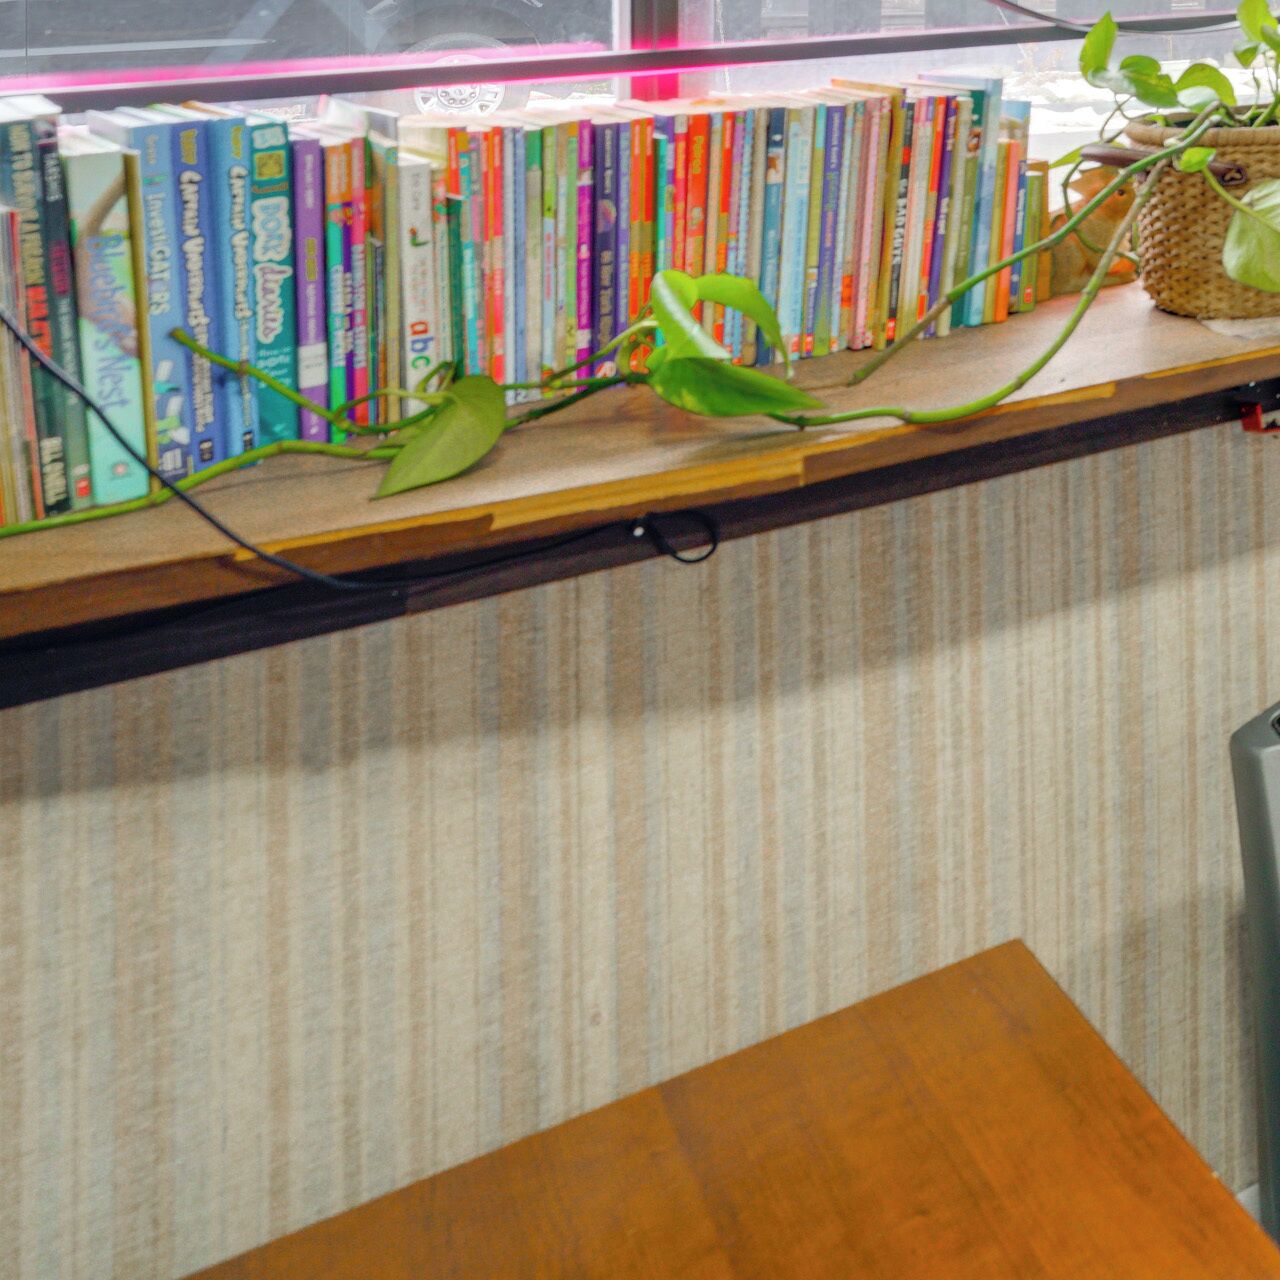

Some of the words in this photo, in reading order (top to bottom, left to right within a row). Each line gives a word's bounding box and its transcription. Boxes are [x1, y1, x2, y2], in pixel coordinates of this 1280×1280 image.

[255, 199, 289, 259] DORK
[896, 197, 908, 228] BAD
[893, 228, 906, 266] GUYS
[409, 321, 435, 370] abc
[97, 355, 132, 413] Nest
